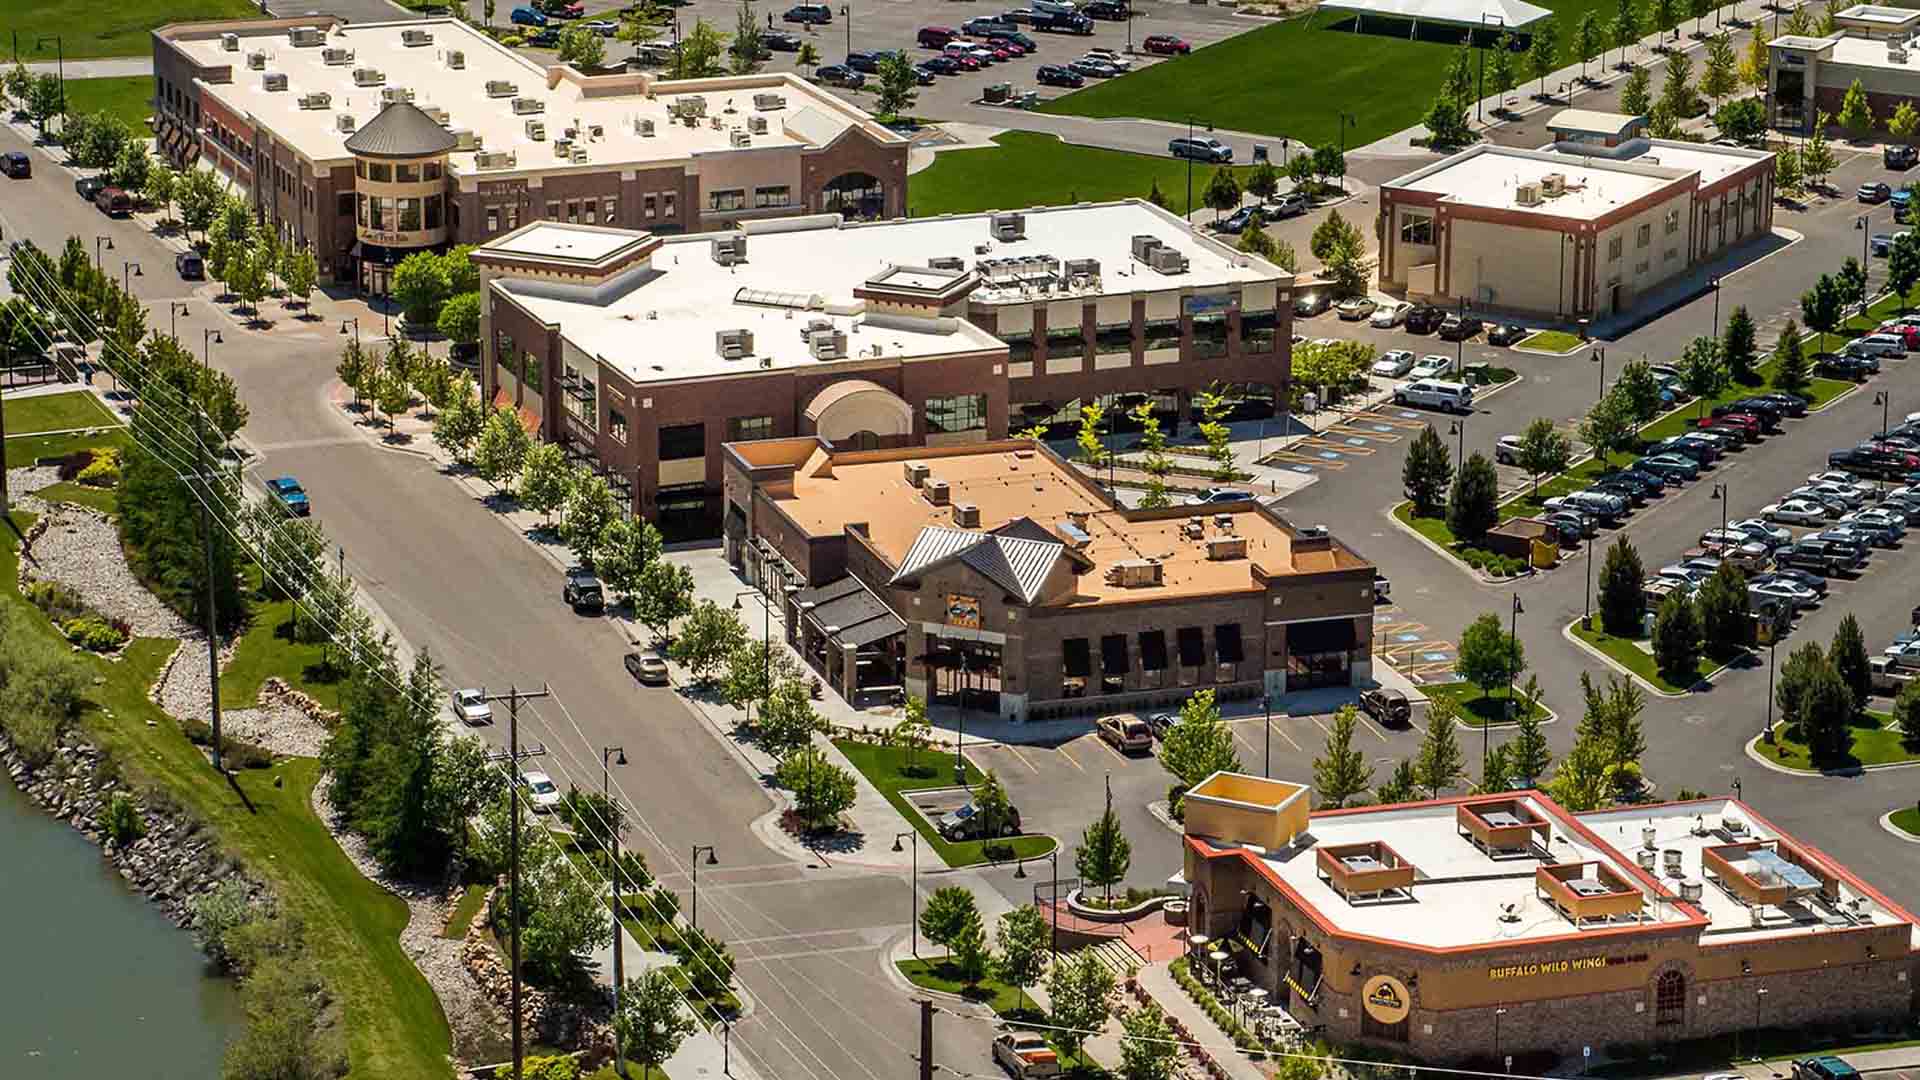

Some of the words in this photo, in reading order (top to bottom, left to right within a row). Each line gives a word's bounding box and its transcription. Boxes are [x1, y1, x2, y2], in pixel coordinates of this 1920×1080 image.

[1489, 965, 1537, 979] BUFFALO
[1540, 961, 1569, 974] WILD
[1572, 957, 1606, 970] WINGS
